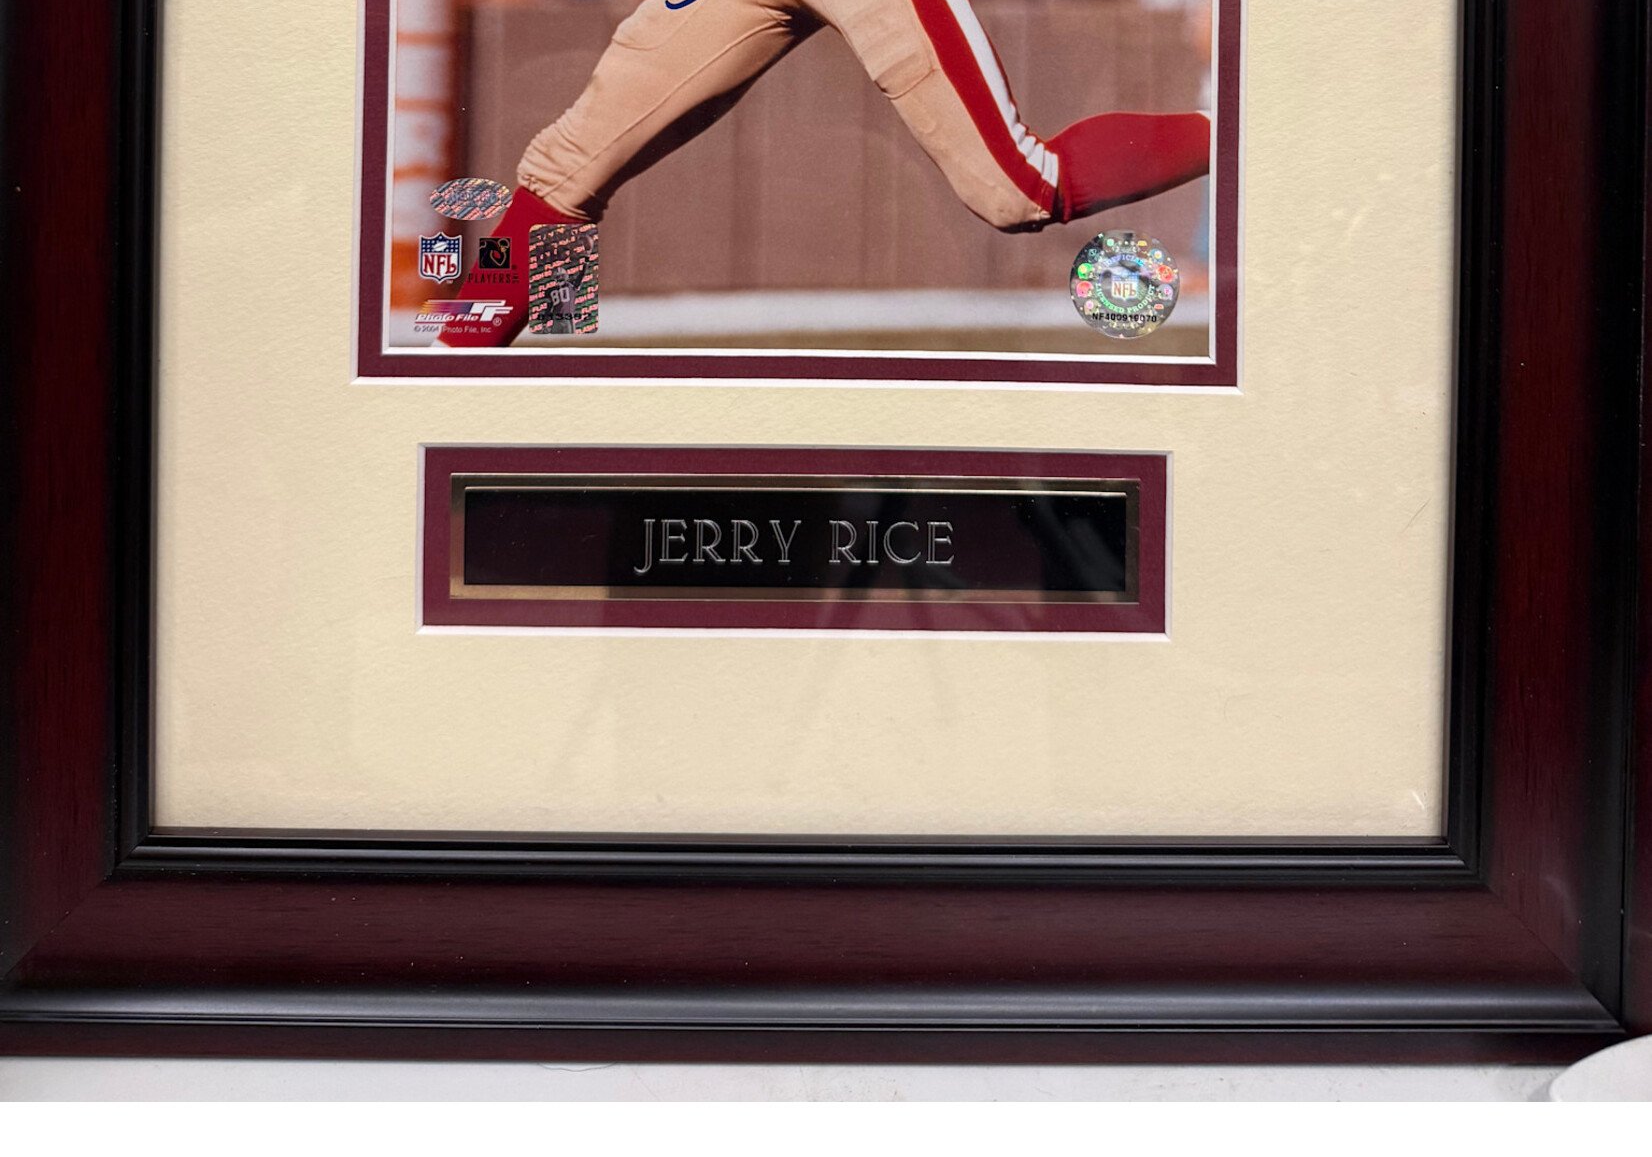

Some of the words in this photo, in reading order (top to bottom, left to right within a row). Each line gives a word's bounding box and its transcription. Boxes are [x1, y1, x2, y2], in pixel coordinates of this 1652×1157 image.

[423, 254, 457, 276] NFL
[468, 273, 511, 284] PLAYERS
[551, 287, 570, 305] 80
[1113, 282, 1137, 298] NFL
[416, 313, 455, 322] Photo
[633, 518, 801, 575] JERRY
[829, 520, 955, 565] RICE
